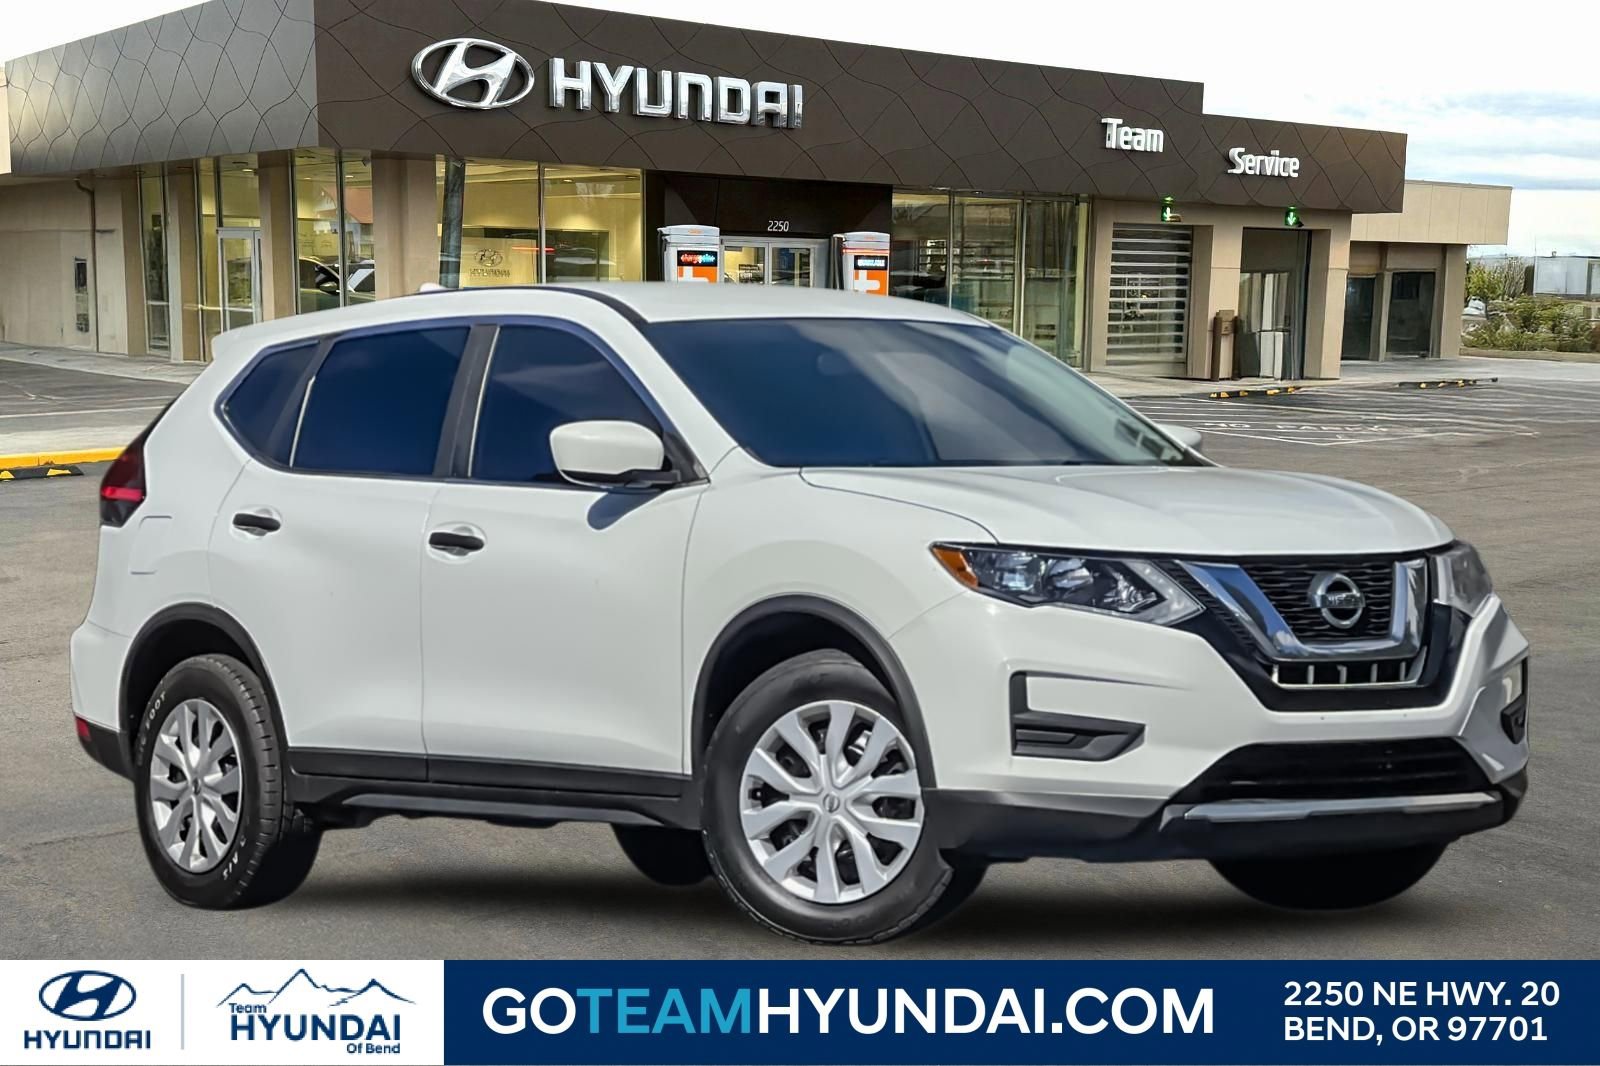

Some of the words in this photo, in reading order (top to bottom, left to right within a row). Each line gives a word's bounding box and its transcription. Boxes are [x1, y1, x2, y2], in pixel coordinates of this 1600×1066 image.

[549, 57, 803, 129] HYUNDAI
[1101, 117, 1164, 153] Team
[1227, 147, 1300, 178] Service
[767, 220, 790, 232] 2250
